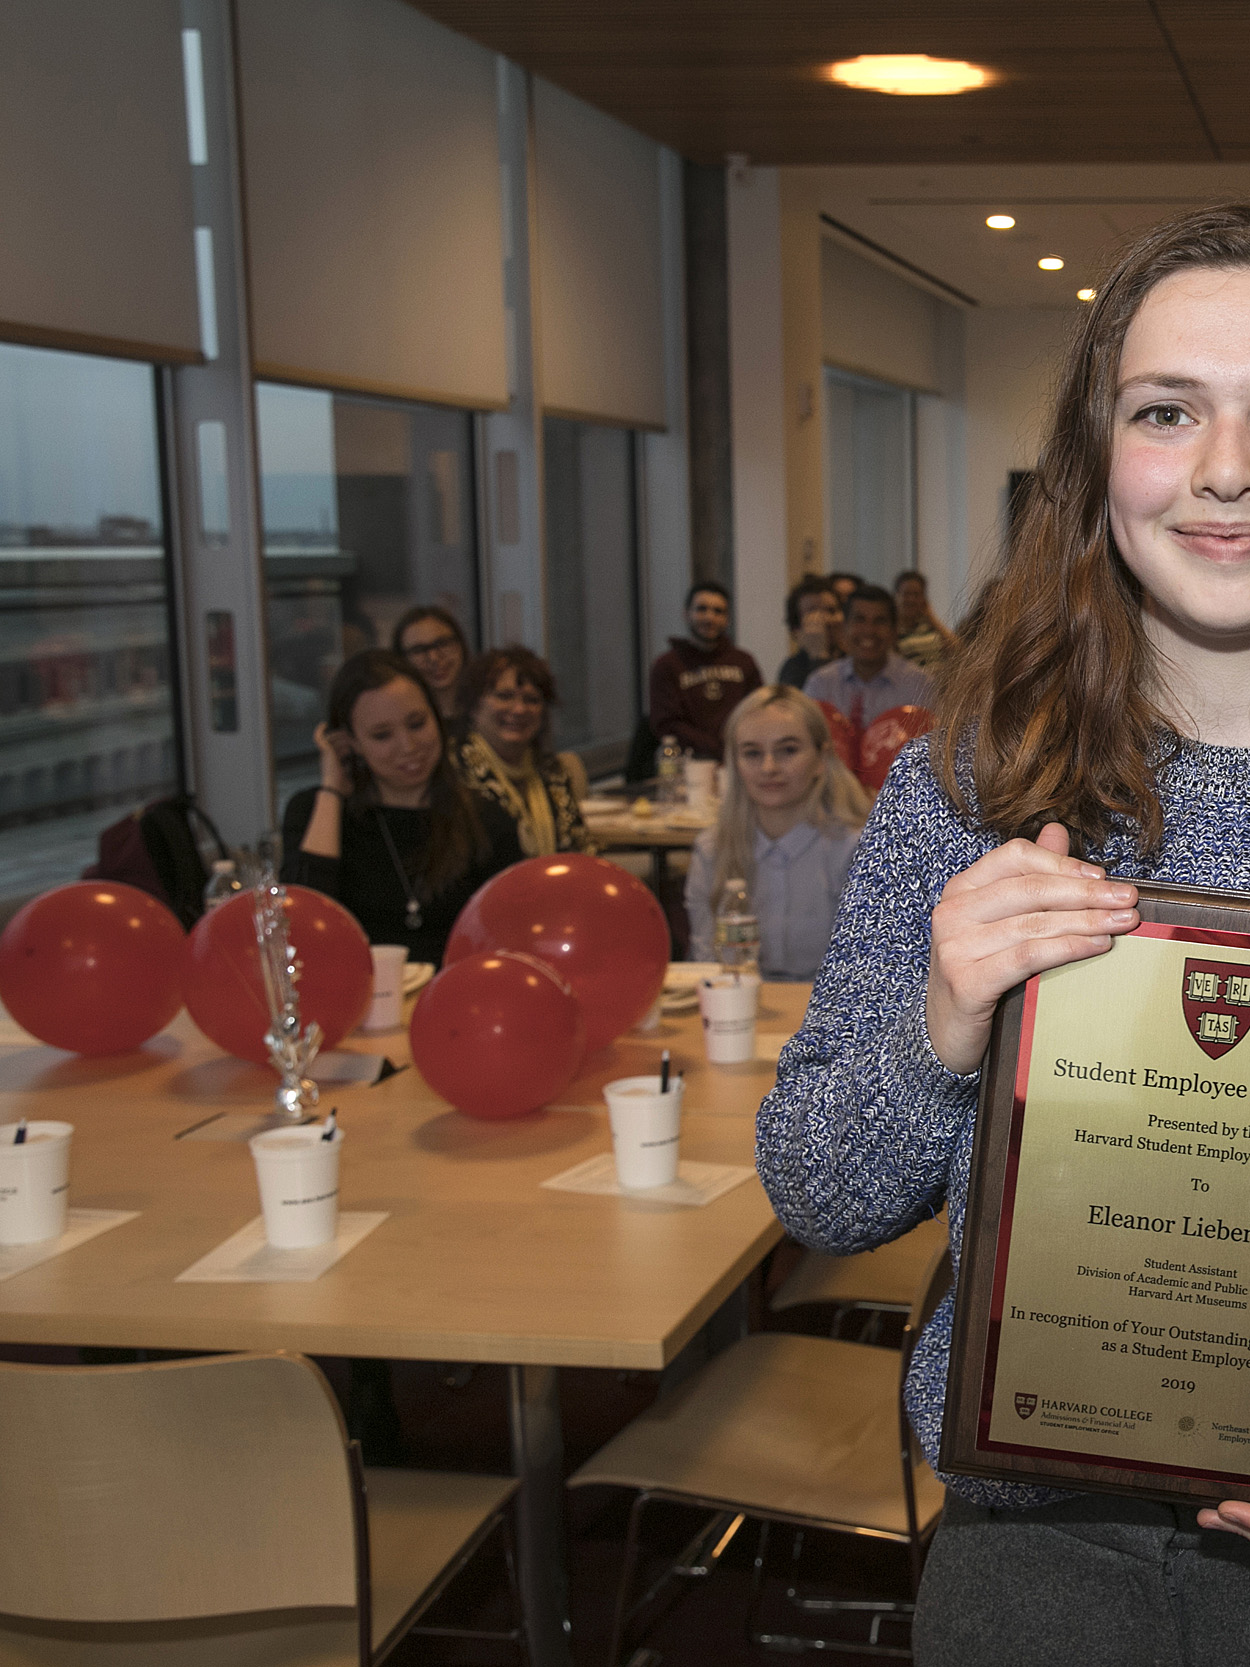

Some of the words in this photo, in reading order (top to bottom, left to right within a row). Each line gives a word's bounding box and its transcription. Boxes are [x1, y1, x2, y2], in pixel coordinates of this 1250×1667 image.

[1195, 978, 1211, 994] VE
[1232, 982, 1247, 996] RI
[1207, 1018, 1229, 1034] TAS
[1054, 1058, 1137, 1085] Student
[1142, 1068, 1247, 1099] Employee
[1148, 1114, 1218, 1134] Presented
[1222, 1122, 1240, 1140] by
[1074, 1129, 1133, 1148] Harvard
[1137, 1137, 1193, 1155] Student
[1191, 1178, 1210, 1192] To
[1087, 1205, 1176, 1233] Eleanor
[1144, 1258, 1186, 1272] Student
[1189, 1264, 1238, 1279] Assistant
[1077, 1266, 1120, 1280] Division
[1124, 1272, 1136, 1281] of
[1137, 1273, 1189, 1289] Academic
[1191, 1280, 1212, 1291] and
[1214, 1282, 1248, 1295] Public
[1128, 1286, 1170, 1301] Harvard
[1174, 1292, 1193, 1303] Art
[1196, 1294, 1247, 1309] Museums
[1010, 1306, 1025, 1320] In
[1029, 1309, 1109, 1331] recognition
[1113, 1320, 1129, 1332] of
[1131, 1321, 1166, 1337] Your
[1102, 1342, 1117, 1352] as
[1119, 1343, 1128, 1353] a
[1132, 1342, 1188, 1360] Student
[1161, 1378, 1196, 1393] 2019
[1041, 1412, 1080, 1423] Admissions
[1090, 1417, 1122, 1428] Financial
[1123, 1422, 1136, 1430] Aid
[1042, 1399, 1097, 1414] HARVARD
[1100, 1407, 1152, 1422] COLLEGE
[1211, 1422, 1249, 1434] Northeast
